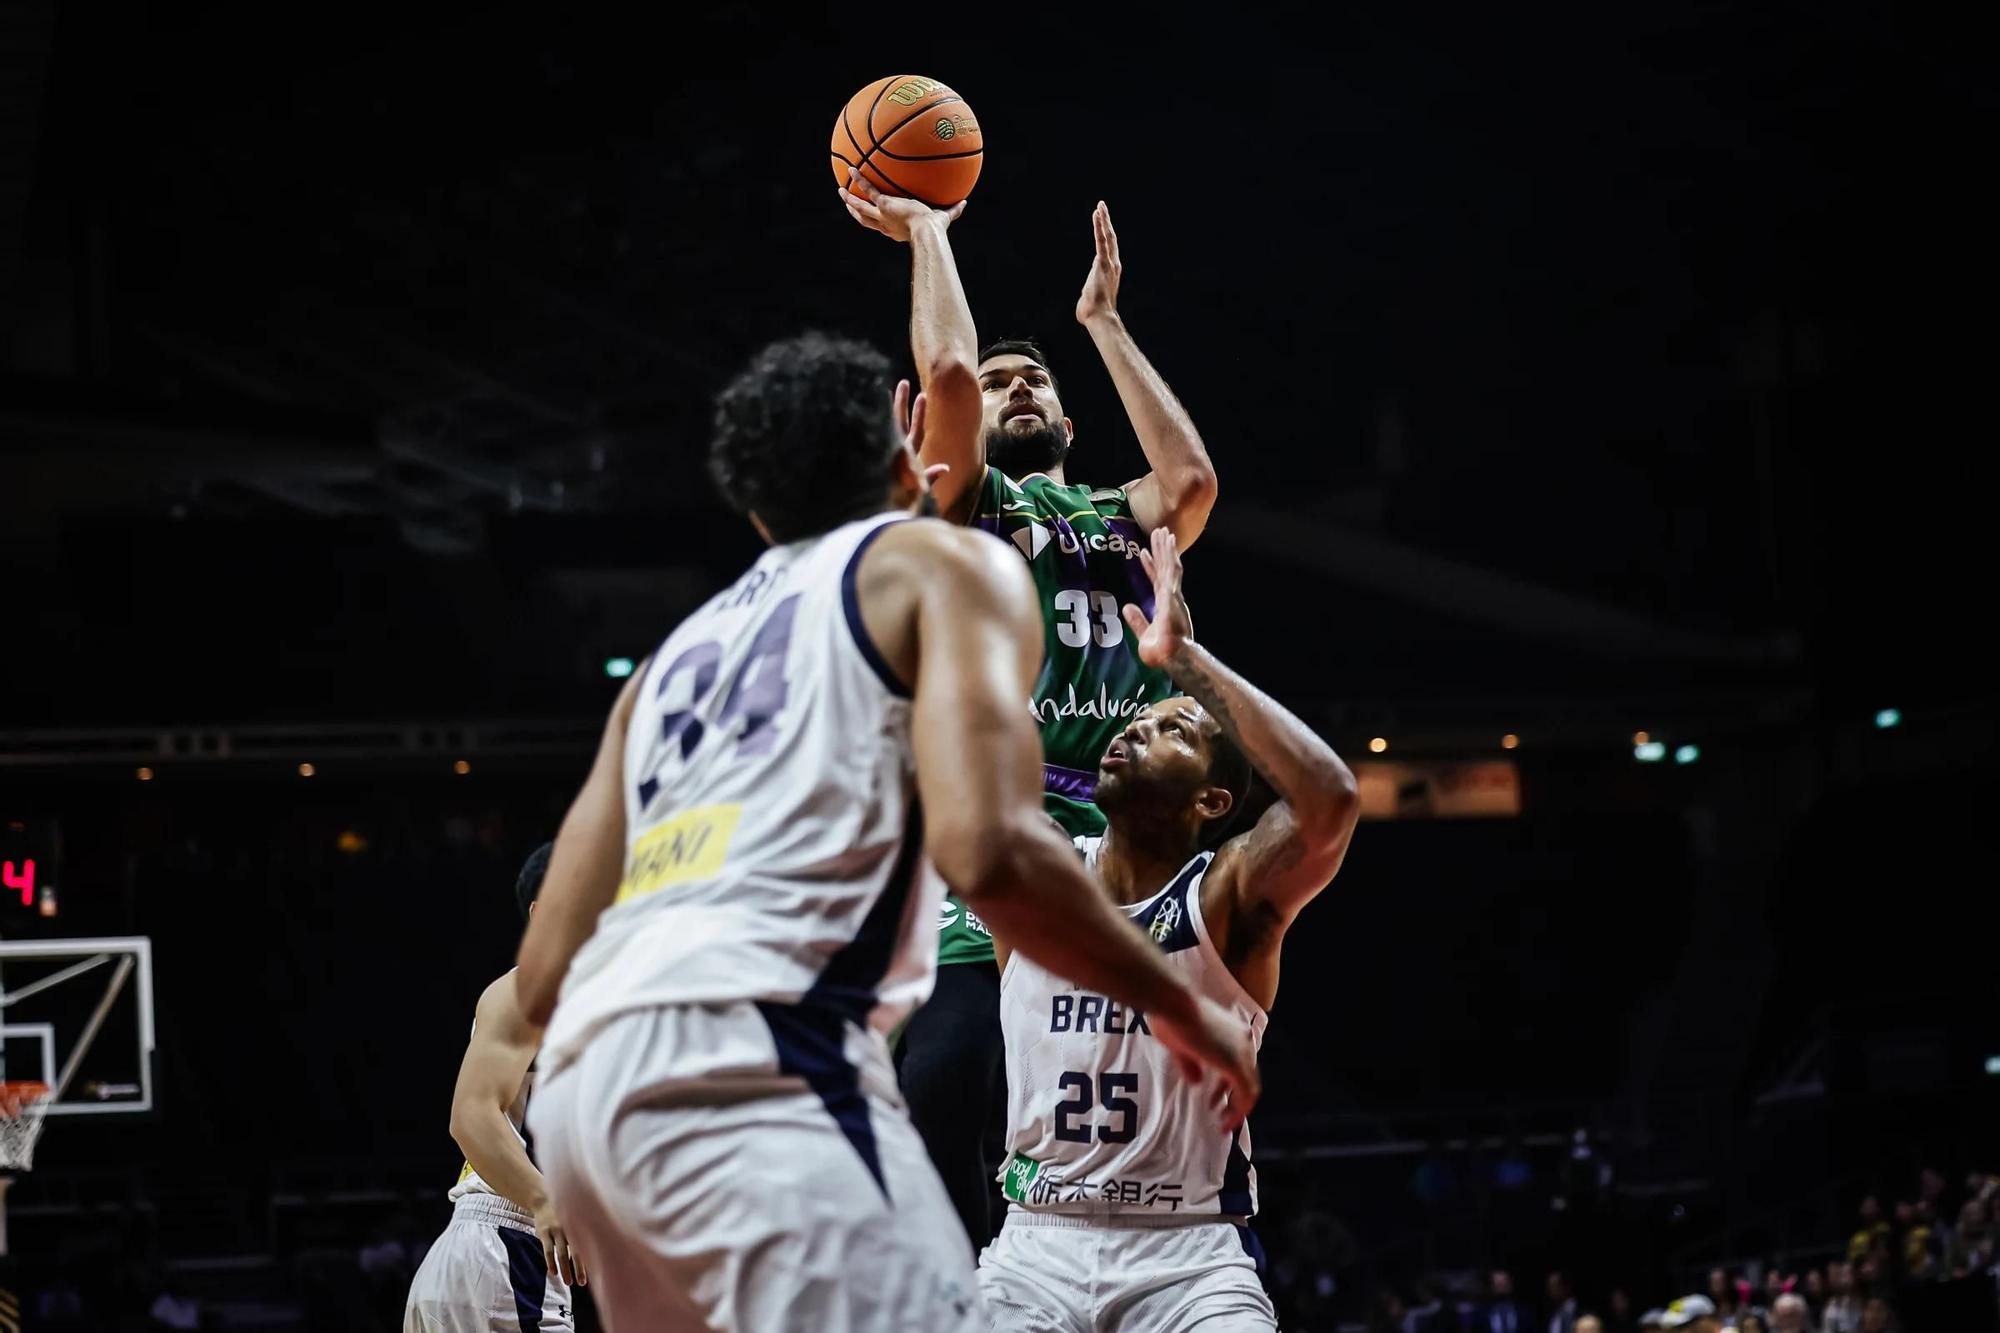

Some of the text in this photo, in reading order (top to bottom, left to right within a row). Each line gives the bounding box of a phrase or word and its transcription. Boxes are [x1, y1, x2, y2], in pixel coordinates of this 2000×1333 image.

[1059, 531, 1141, 560] Uicaja
[1054, 589, 1124, 648] 33
[3, 859, 35, 906] 4
[1050, 995, 1152, 1035] BREX
[1055, 1071, 1138, 1144] 25
